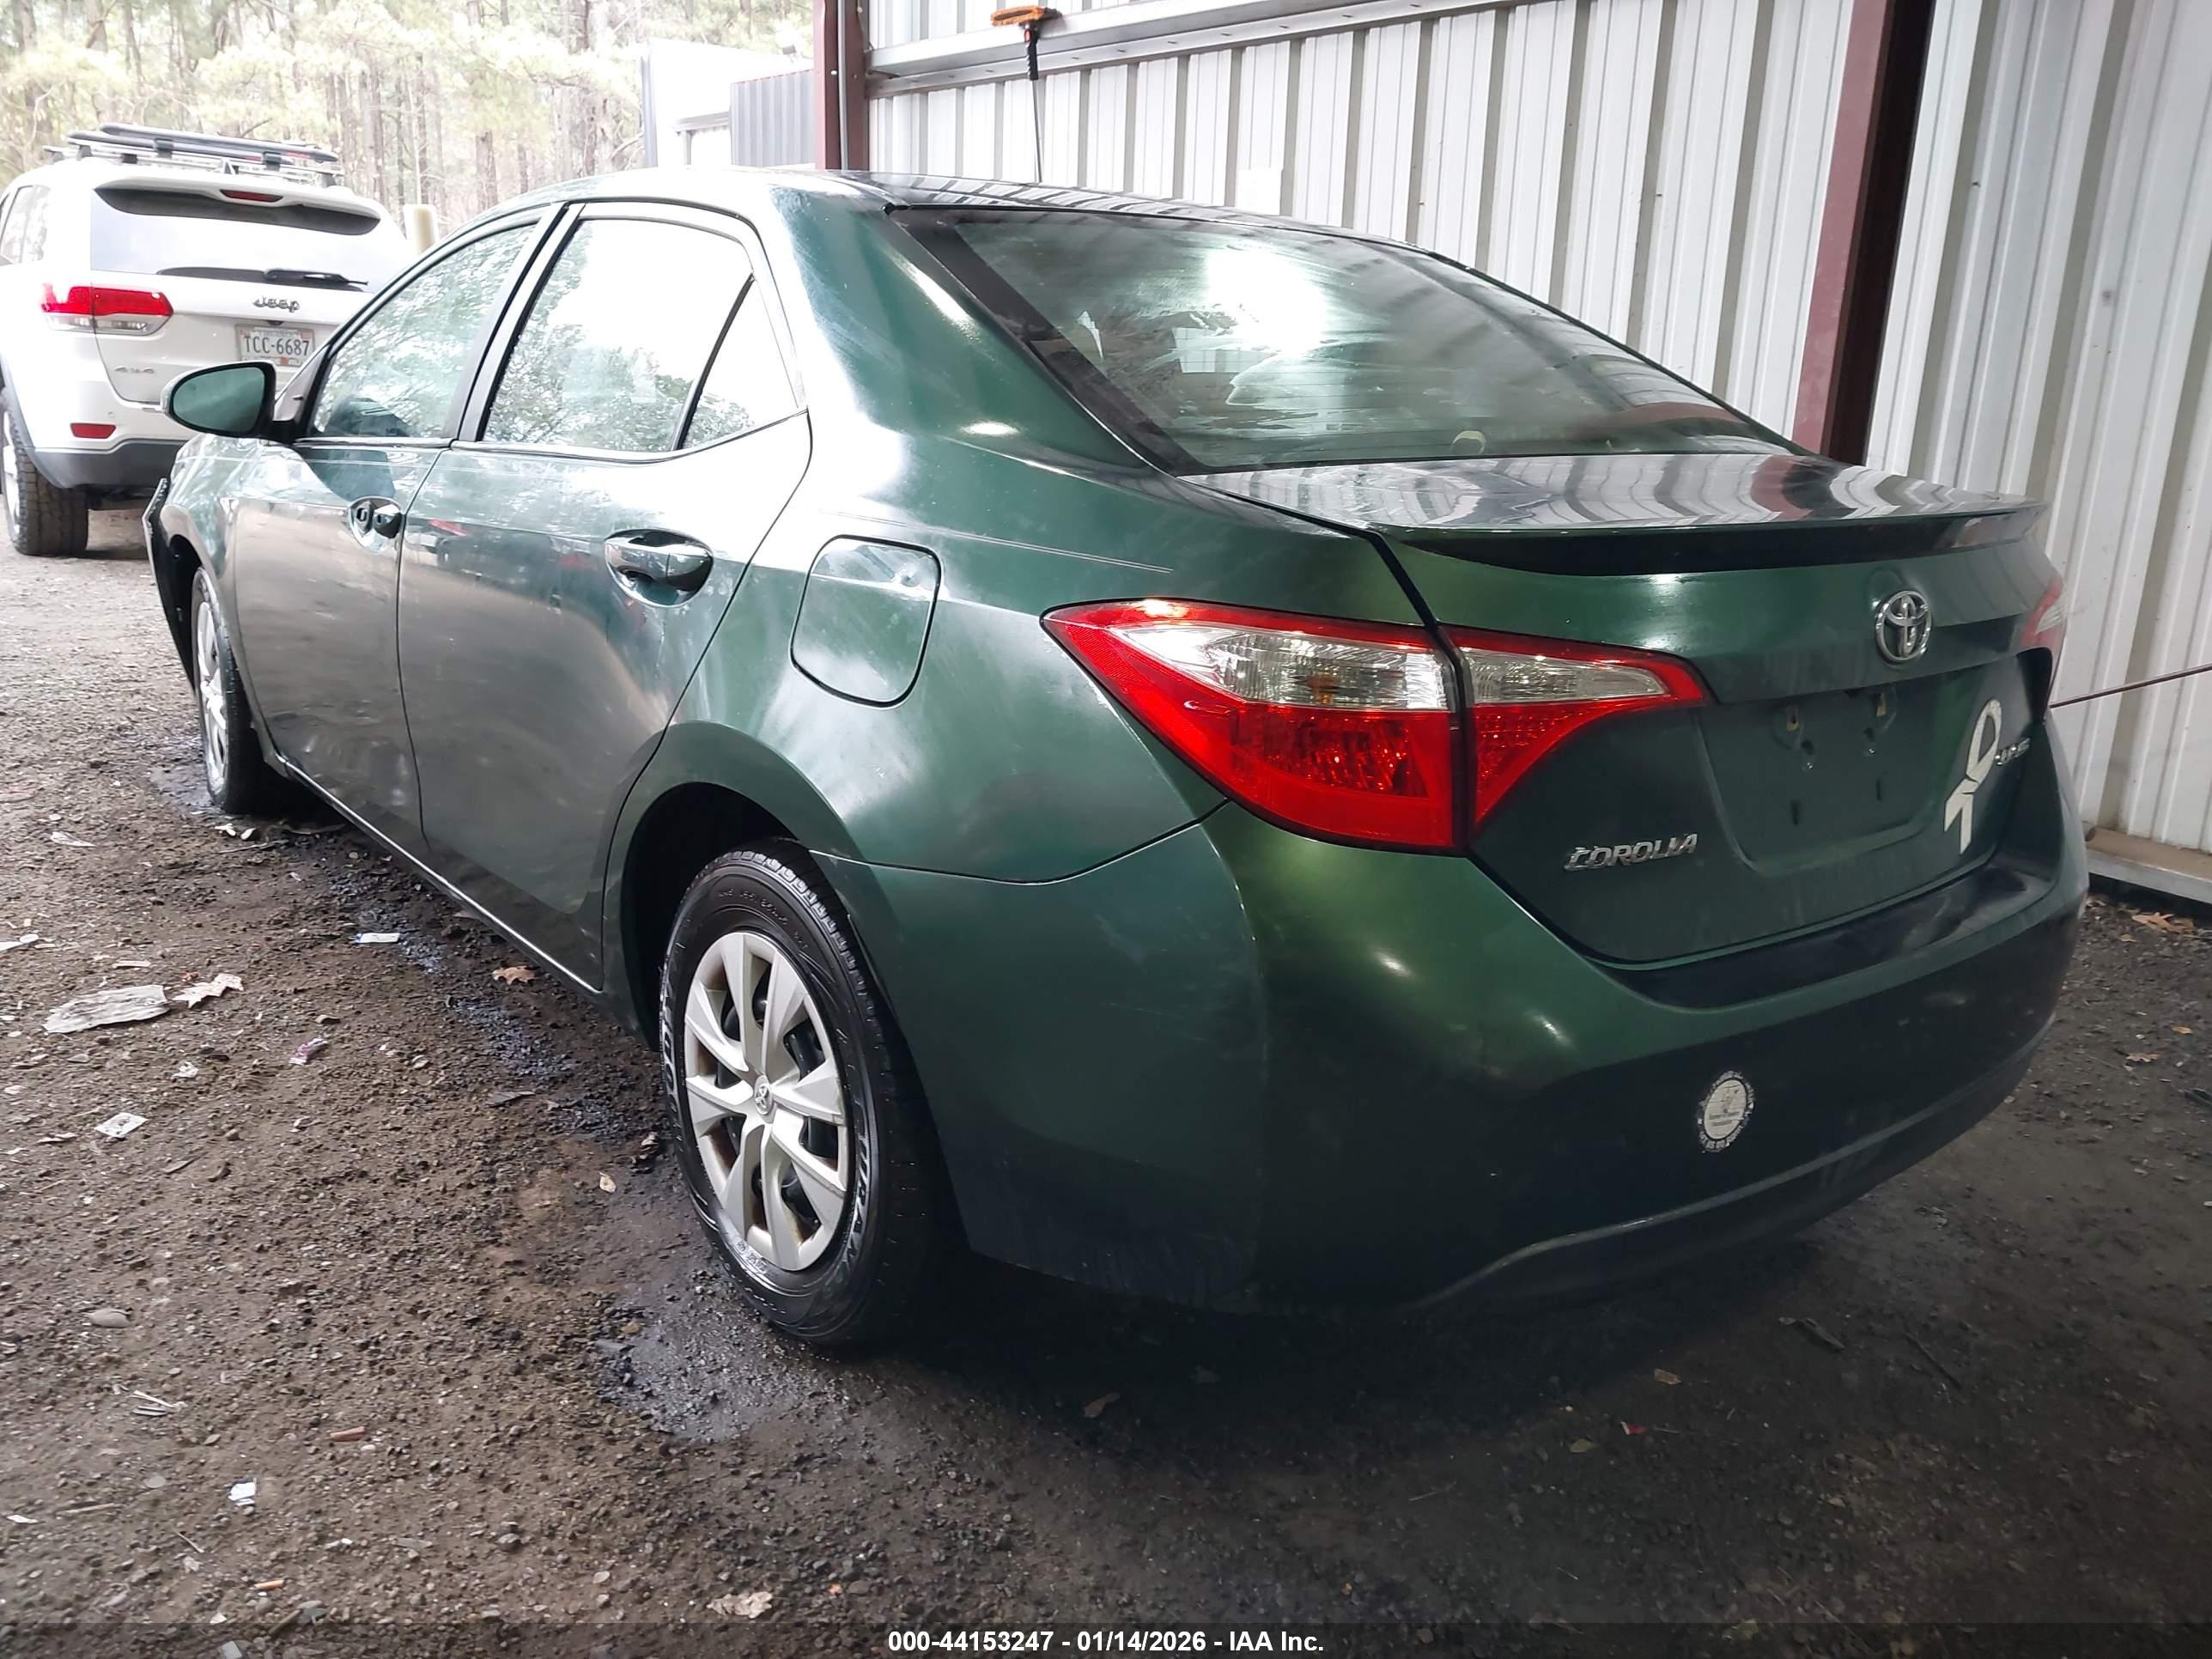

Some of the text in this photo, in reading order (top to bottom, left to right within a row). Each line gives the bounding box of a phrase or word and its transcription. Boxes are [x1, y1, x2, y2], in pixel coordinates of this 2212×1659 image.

[252, 295, 300, 313] Jeep
[244, 336, 310, 356] TCC-6687
[1564, 834, 1698, 872] COROLLA
